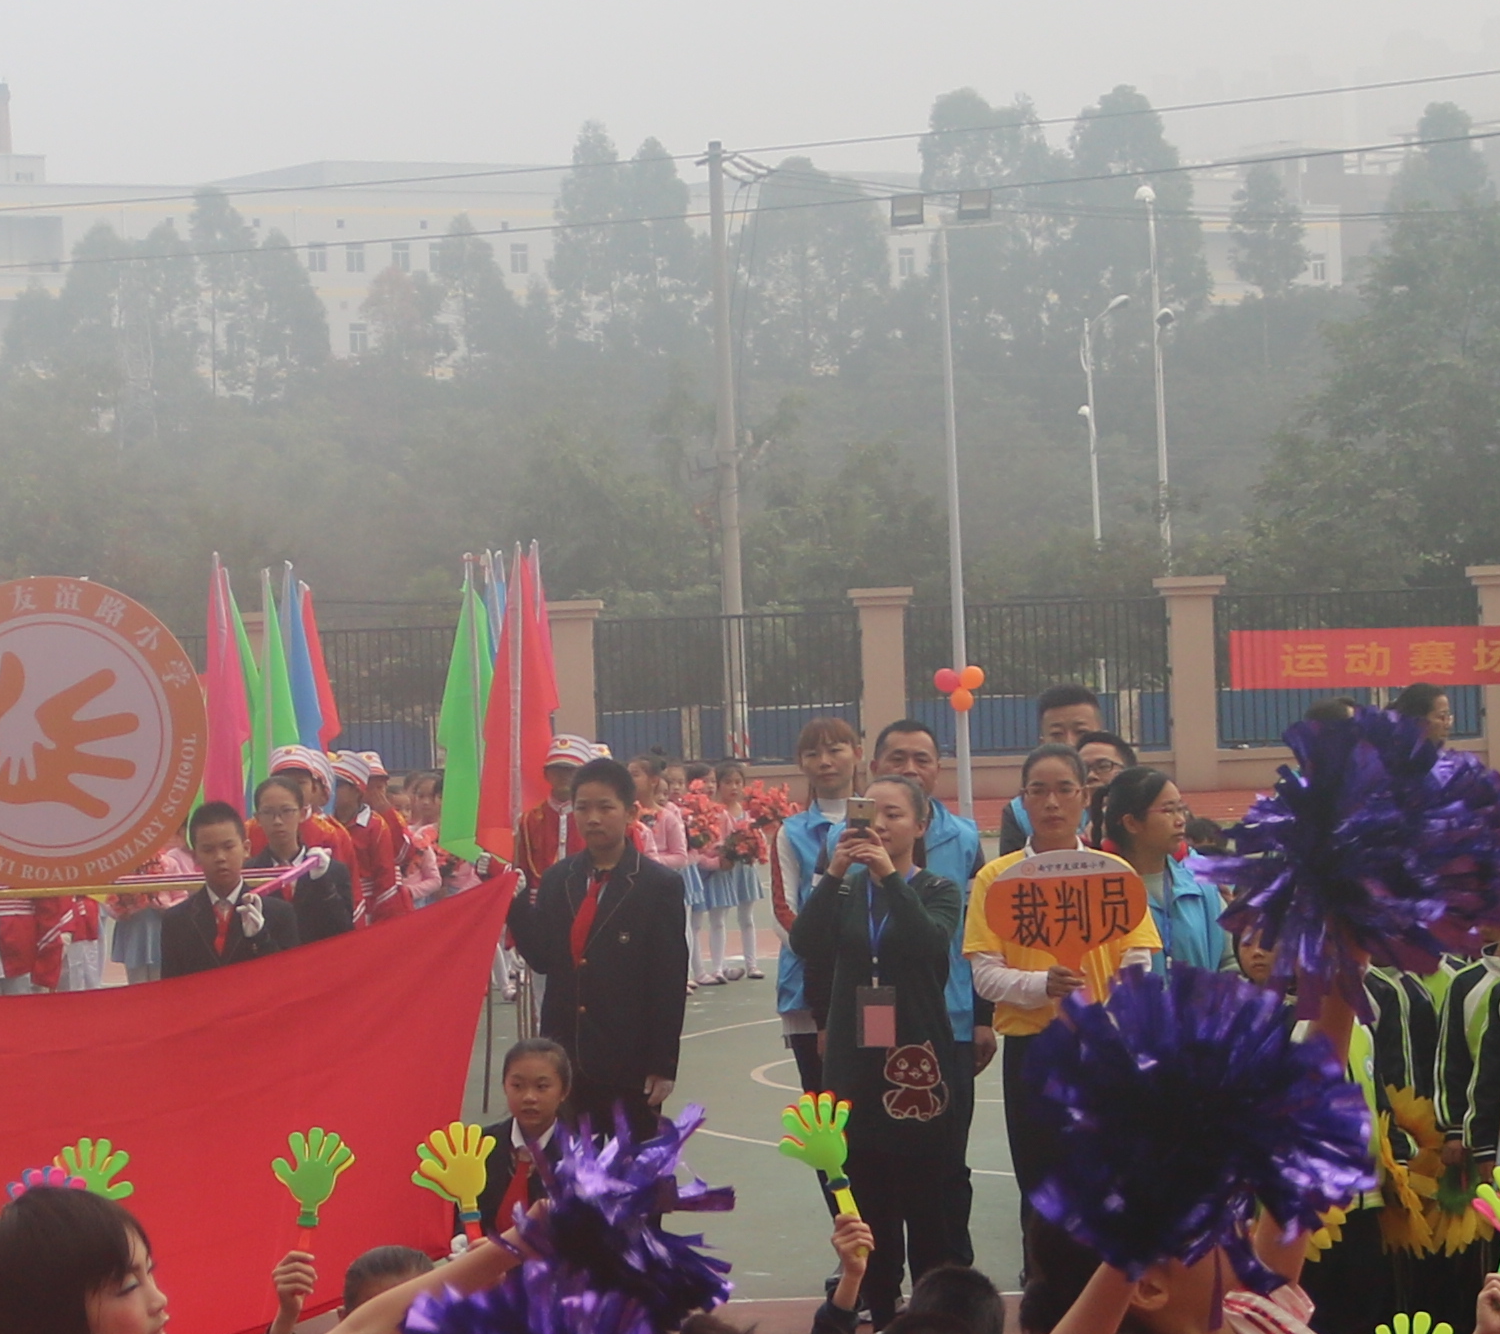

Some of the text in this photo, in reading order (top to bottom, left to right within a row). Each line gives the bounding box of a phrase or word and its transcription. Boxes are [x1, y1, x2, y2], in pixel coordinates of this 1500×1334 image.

[21, 864, 80, 884] ROAD
[85, 821, 167, 878] PRIMARY
[161, 732, 198, 814] SCHOOL
[1011, 876, 1131, 948] 裁判员
